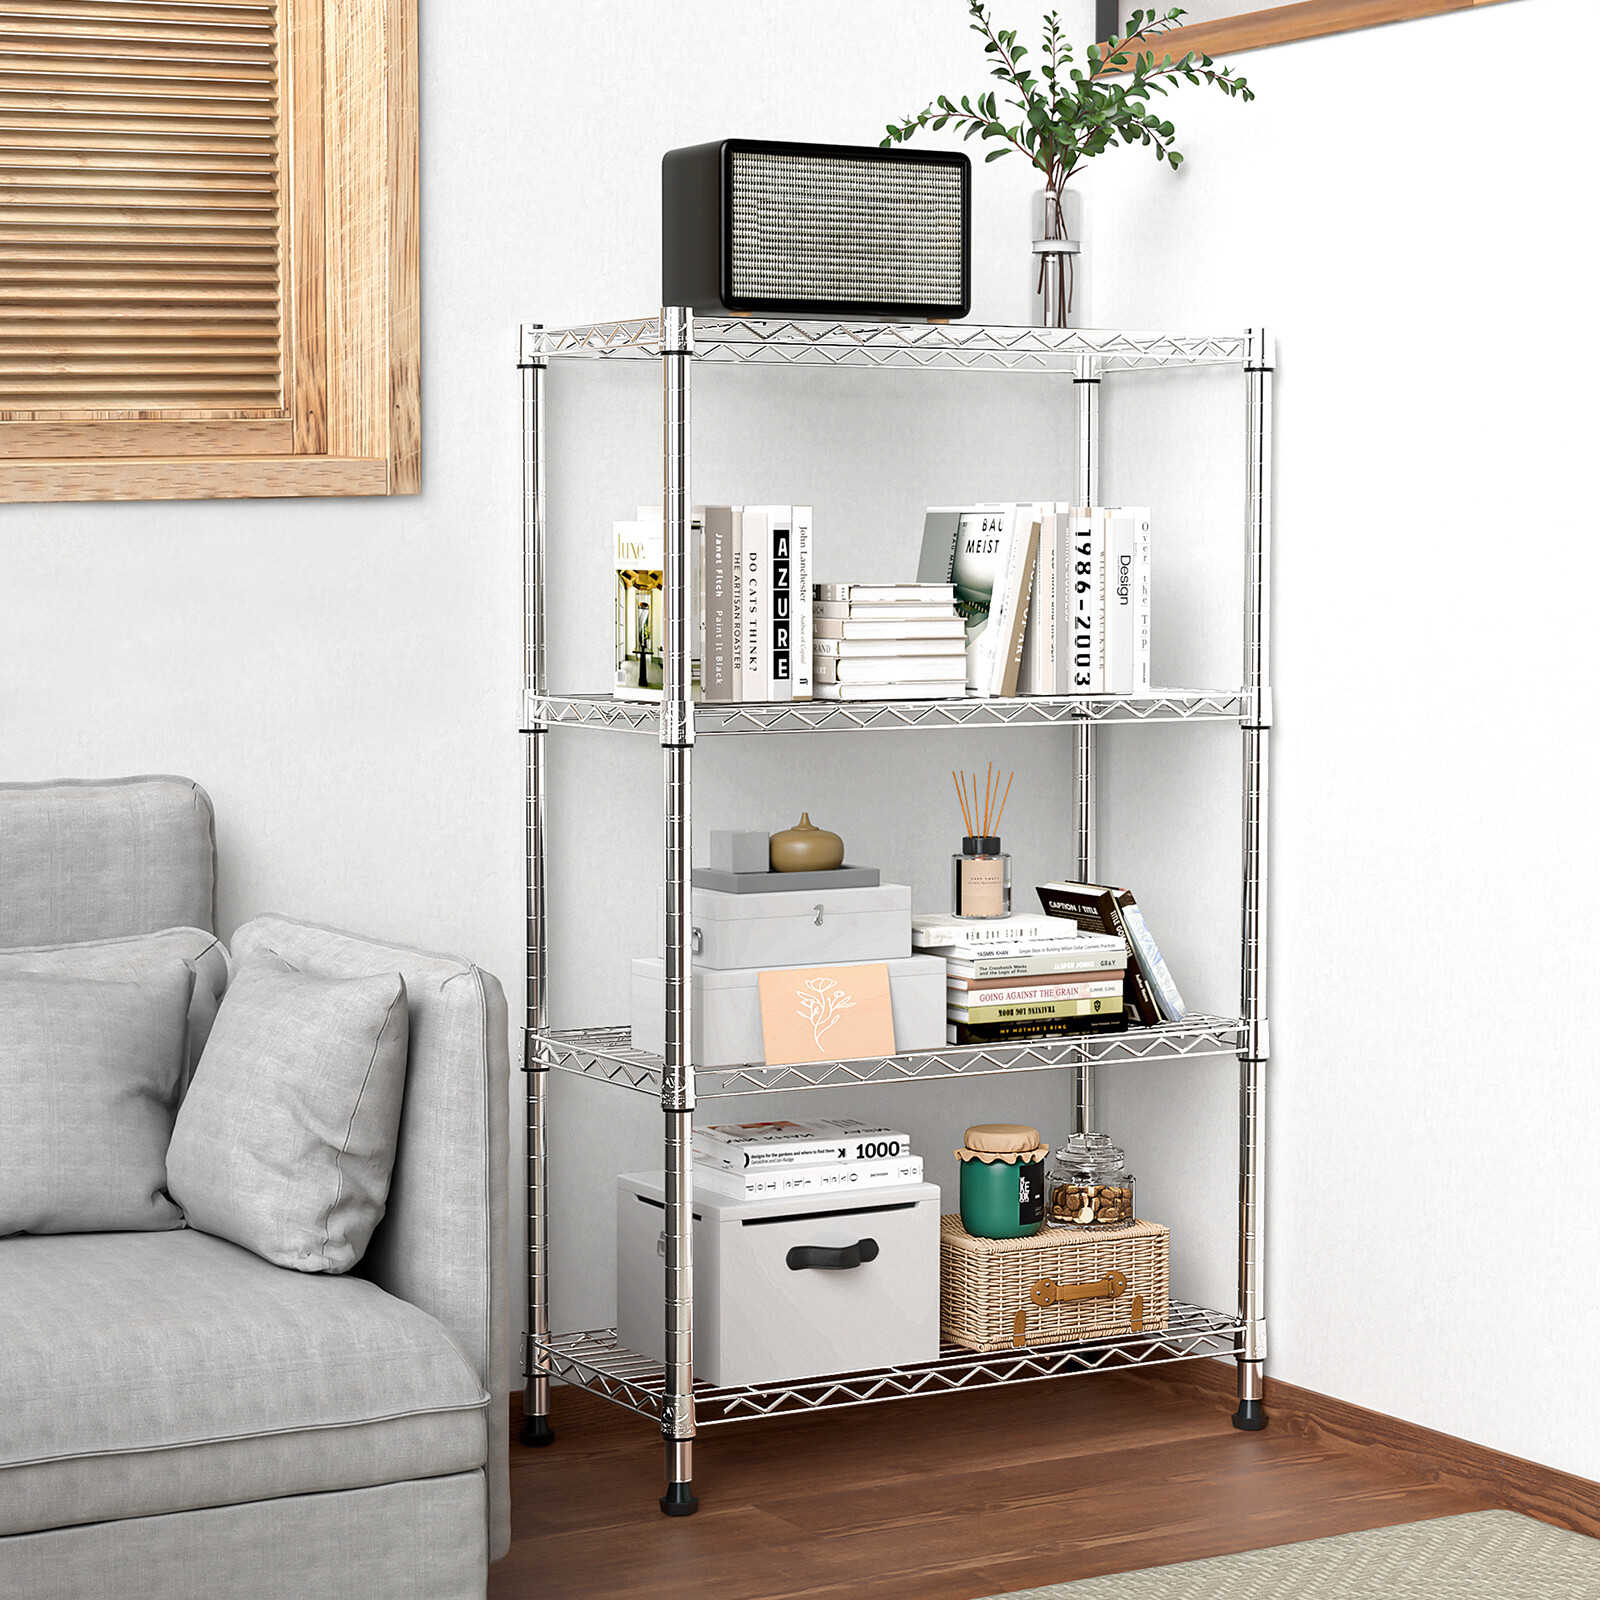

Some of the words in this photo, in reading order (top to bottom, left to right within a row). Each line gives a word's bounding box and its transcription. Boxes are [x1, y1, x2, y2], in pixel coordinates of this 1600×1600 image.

[982, 518, 1004, 532] BAU
[618, 532, 646, 560] luxe.
[798, 526, 808, 548] John
[749, 552, 758, 572] DO
[1116, 555, 1132, 606] Design
[749, 578, 758, 614] CATS
[778, 538, 788, 677] AZURE
[1074, 529, 1091, 686] 1986-2003
[716, 610, 724, 638] Paint
[716, 642, 723, 651] It
[749, 620, 758, 672] THINK?
[716, 656, 724, 684] Black
[1048, 900, 1078, 912] CAPTION
[1082, 906, 1098, 915] TITLE
[1110, 910, 1118, 926] TITLE
[980, 992, 1004, 1002] GOING
[1006, 990, 1037, 1000] AGAINST
[1040, 989, 1054, 998] THE
[1056, 987, 1079, 996] GRAIN
[1028, 1006, 1055, 1014] TRAINING
[856, 1141, 900, 1159] 1000
